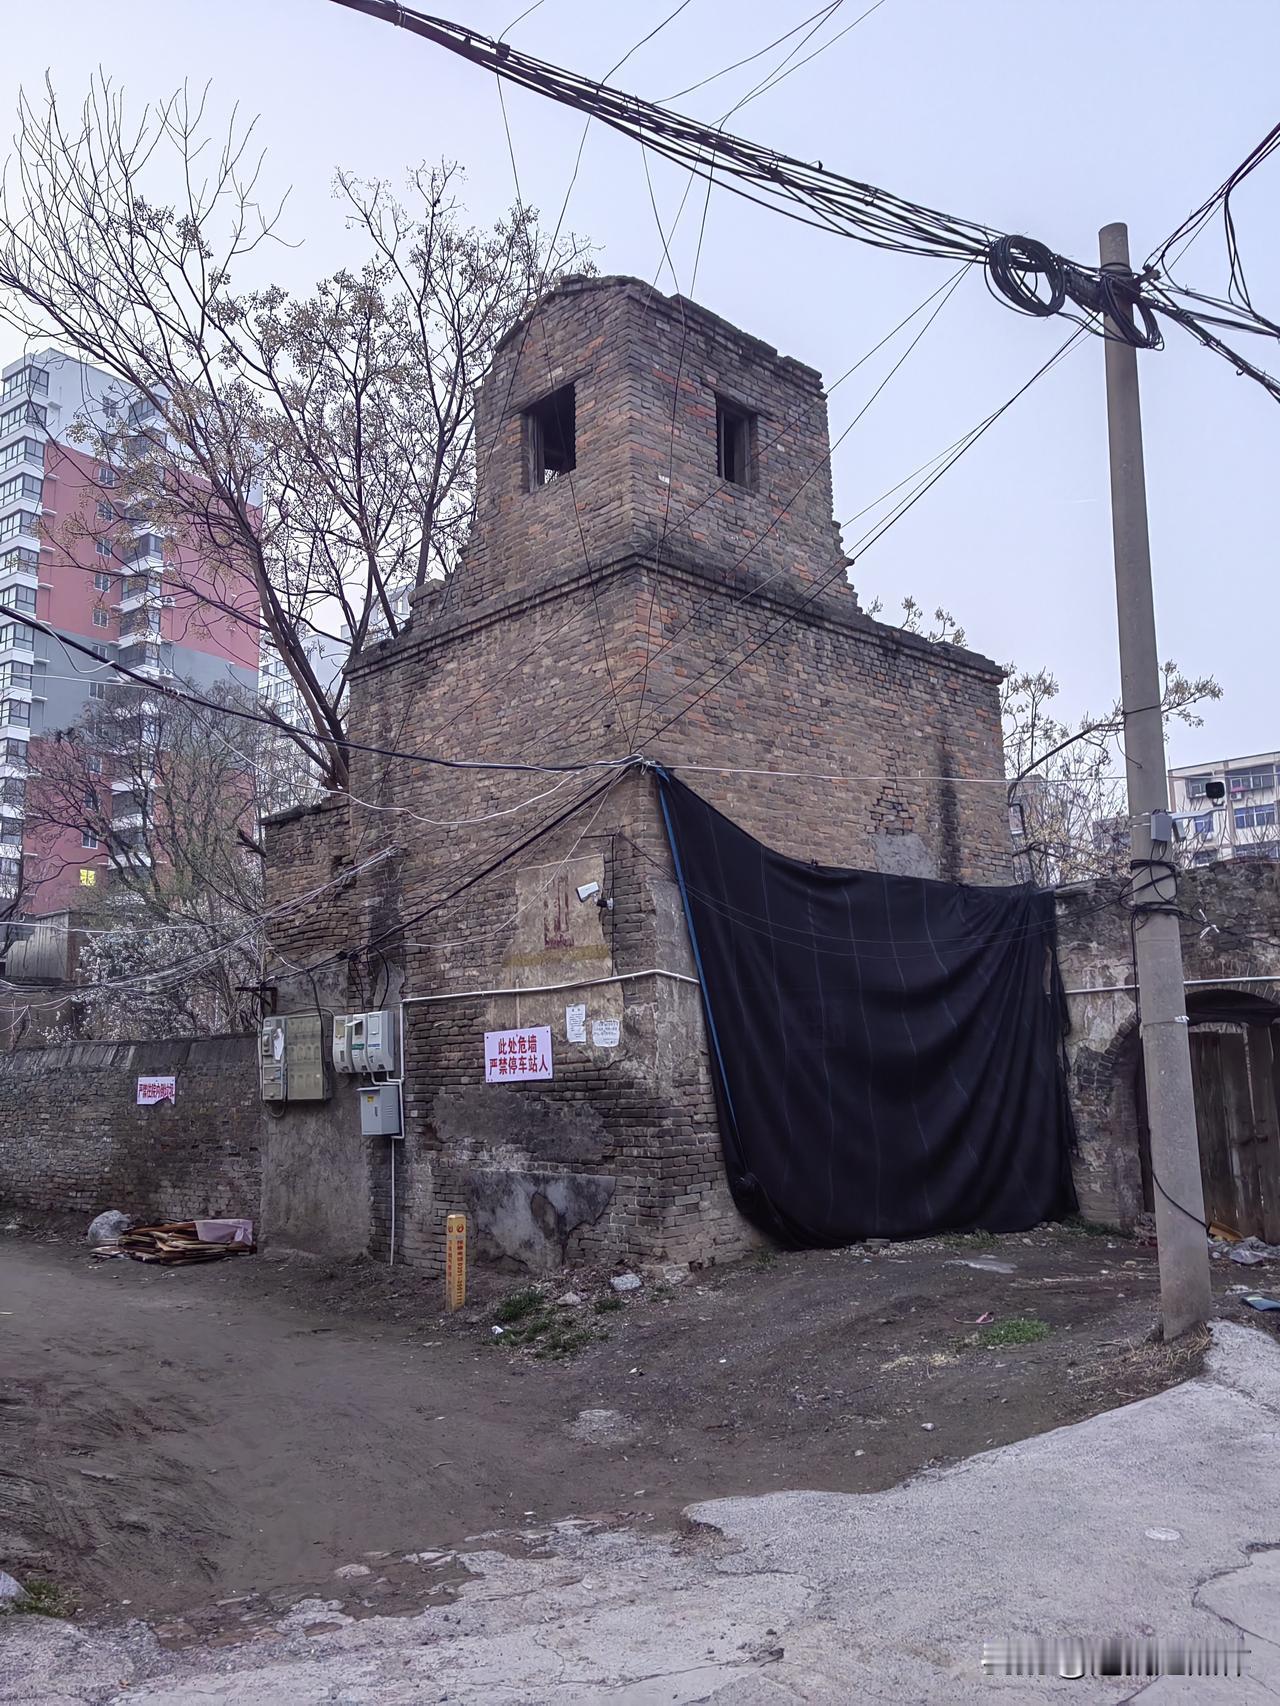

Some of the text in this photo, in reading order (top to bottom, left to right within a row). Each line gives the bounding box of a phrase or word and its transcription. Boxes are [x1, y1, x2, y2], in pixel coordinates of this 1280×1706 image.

[498, 1034, 537, 1055] 此处危墙
[489, 1054, 548, 1075] 严禁停车站人
